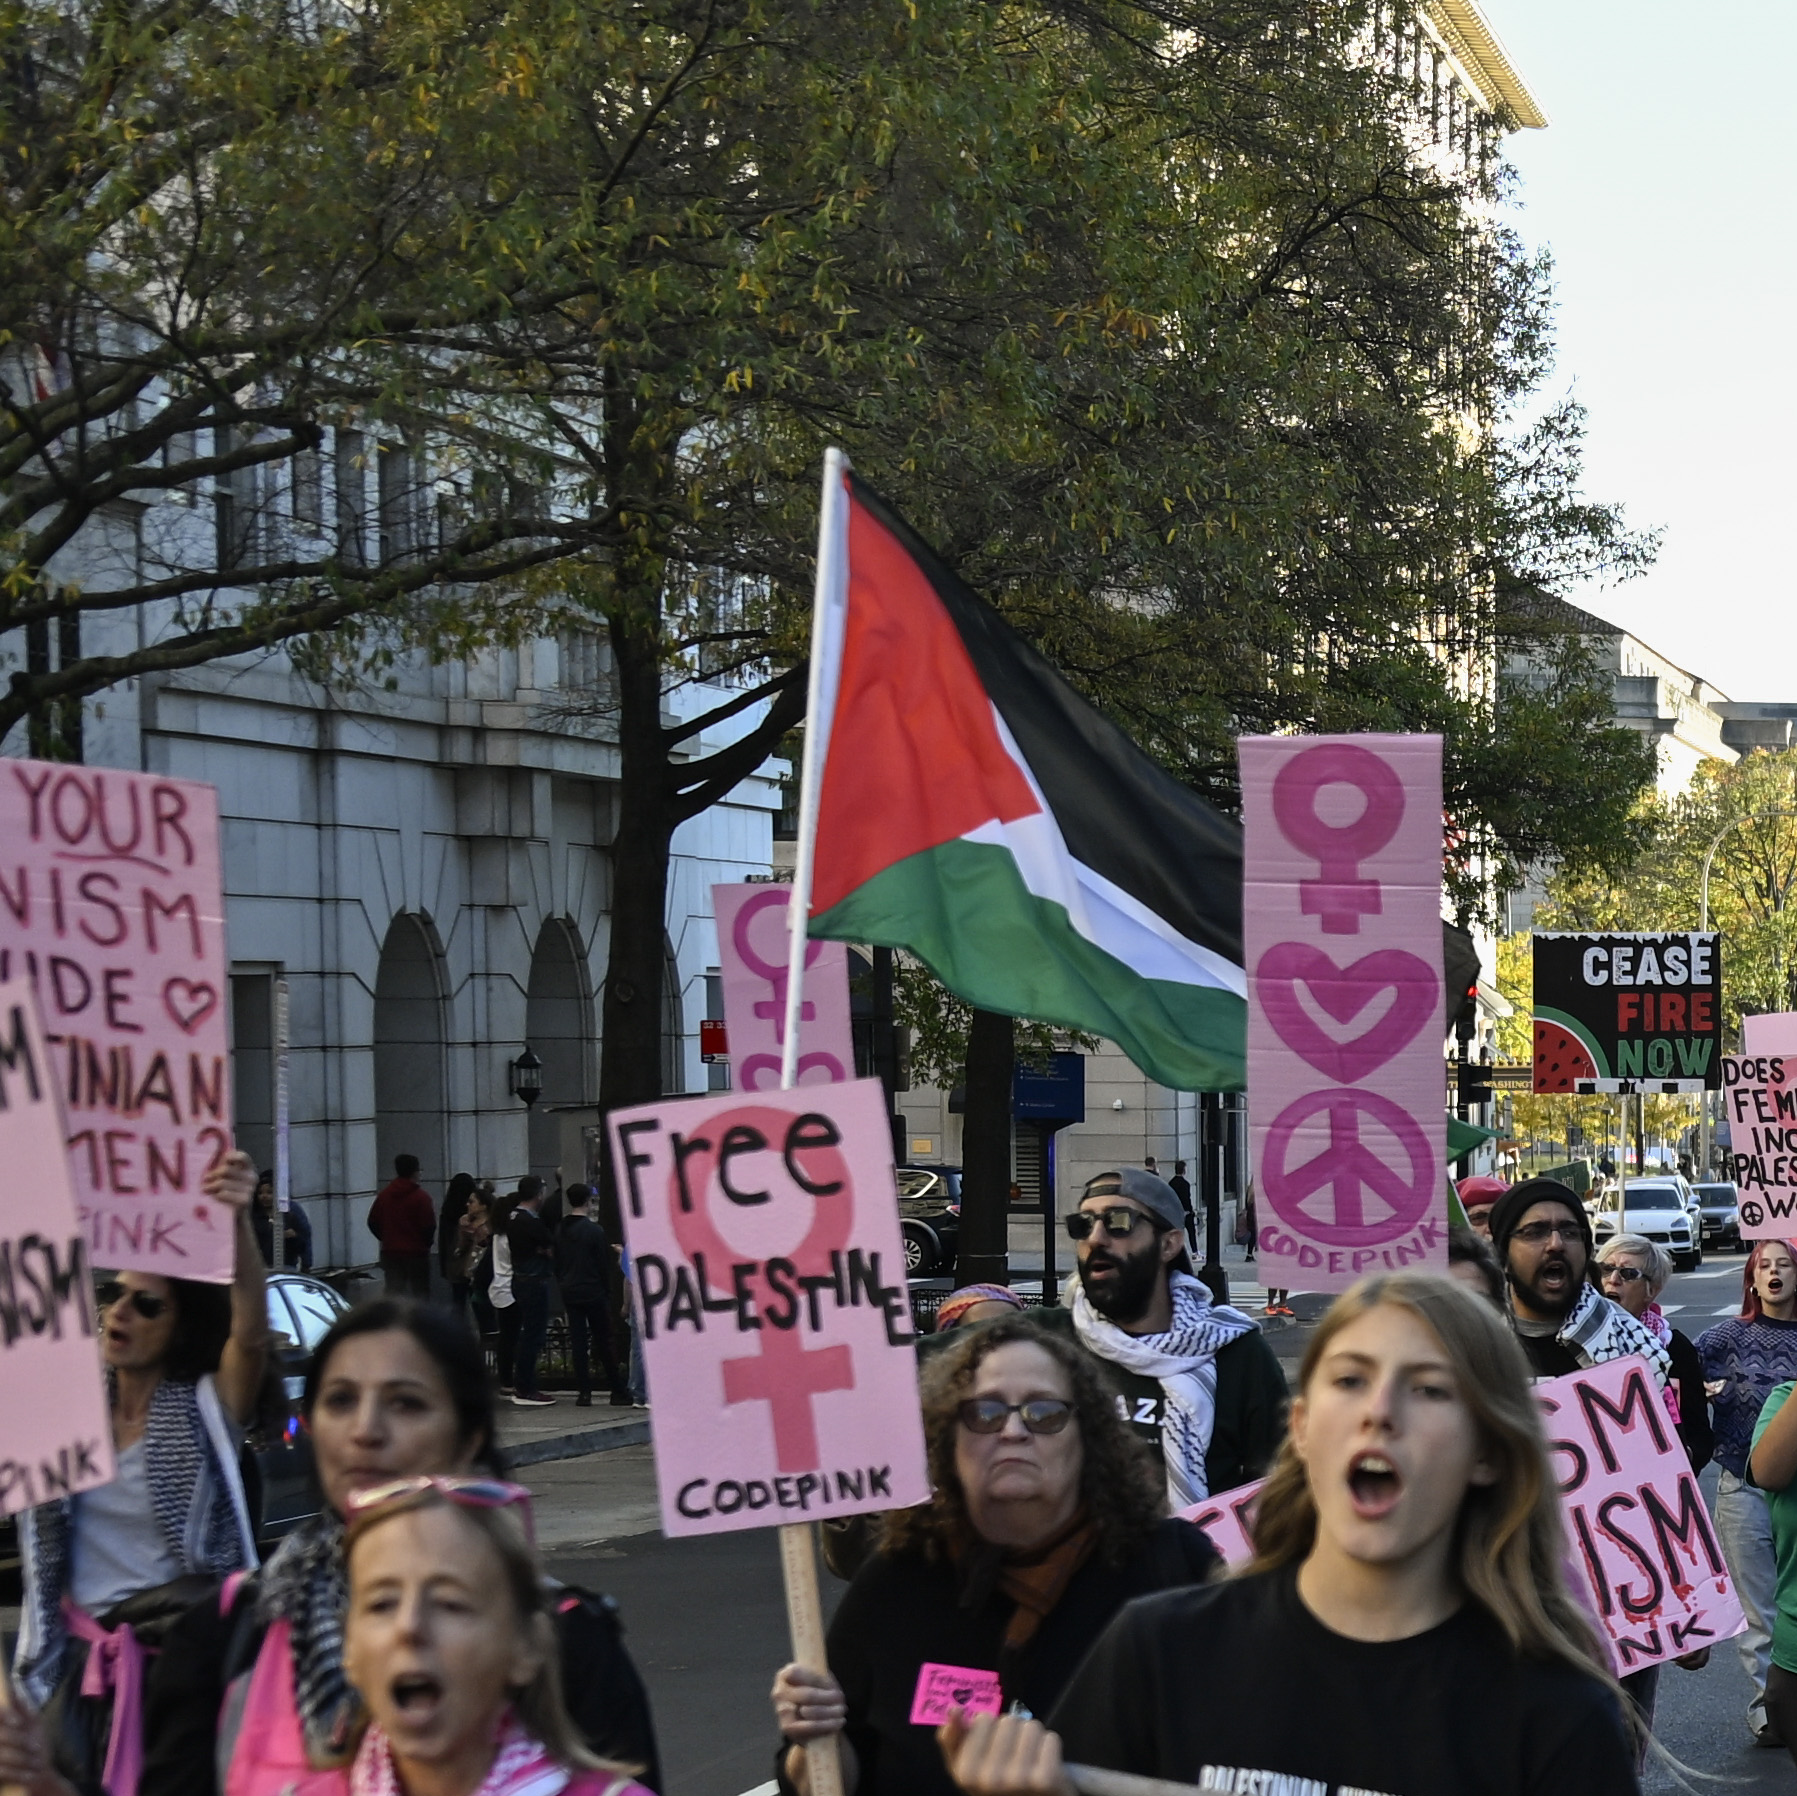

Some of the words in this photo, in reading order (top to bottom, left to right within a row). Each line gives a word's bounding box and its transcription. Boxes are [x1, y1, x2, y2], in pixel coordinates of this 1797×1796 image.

[12, 765, 194, 866] YOUR
[1583, 946, 1713, 987] CEASE
[1617, 992, 1713, 1032] FIRE
[1618, 1038, 1713, 1077] NOW
[1722, 1057, 1785, 1086] DOES
[618, 1113, 843, 1218] Free
[1259, 1217, 1448, 1273] CODEPINK
[635, 1248, 915, 1347] PALESTINE
[677, 1465, 892, 1519] CODEPINK
